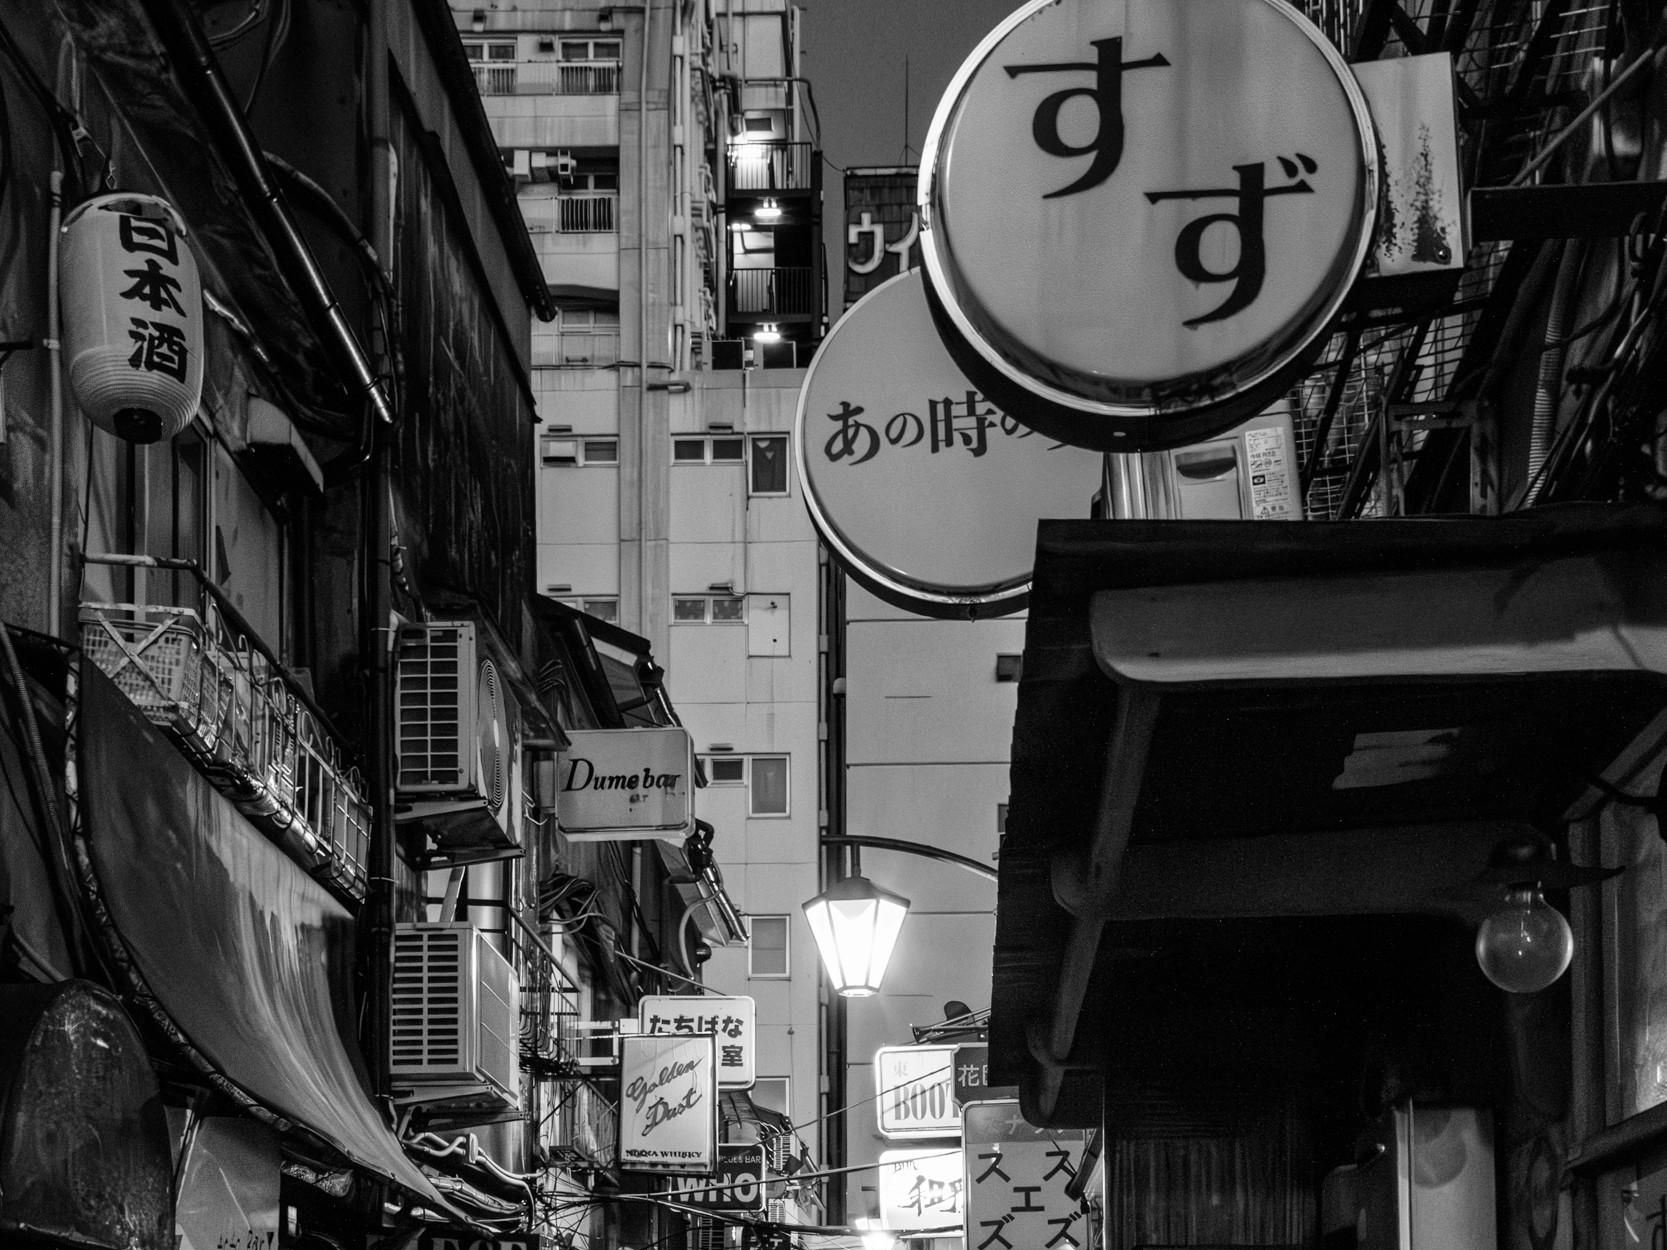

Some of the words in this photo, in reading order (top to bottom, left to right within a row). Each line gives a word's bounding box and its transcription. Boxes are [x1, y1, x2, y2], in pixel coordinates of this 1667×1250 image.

[1003, 36, 1317, 327] すず
[119, 214, 188, 384] 日本酒
[626, 1055, 705, 1114] Golden
[958, 1064, 988, 1088] 花
[642, 1088, 702, 1136] Dust
[745, 1156, 761, 1164] BAR
[677, 1173, 758, 1203] WHO
